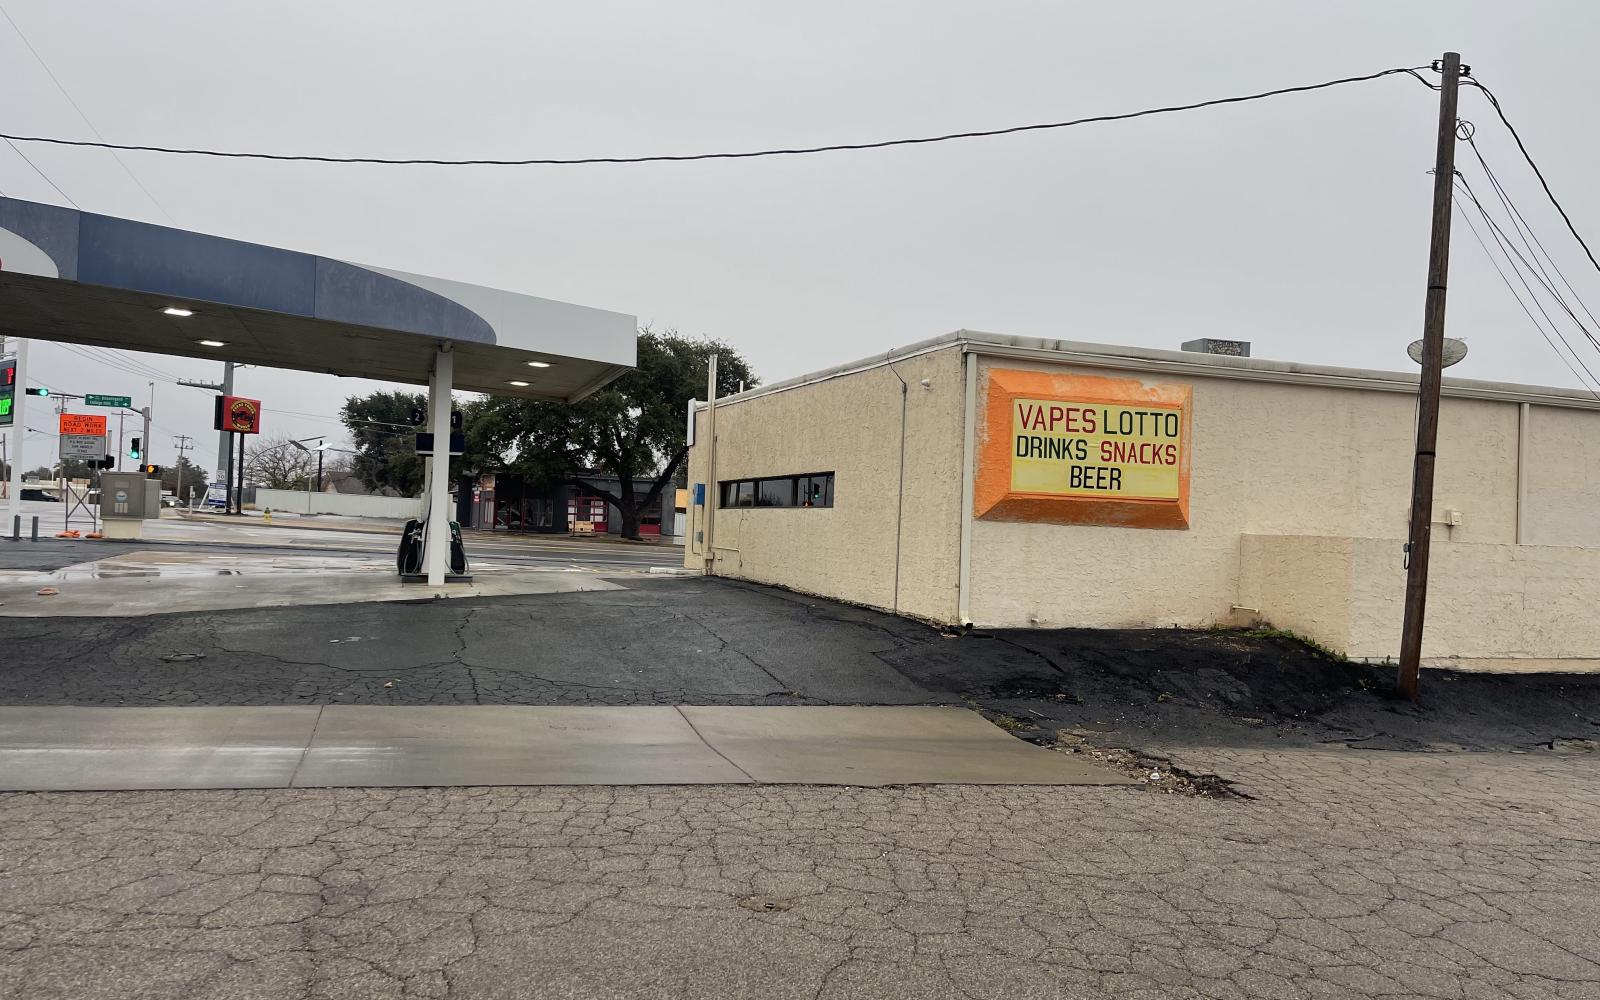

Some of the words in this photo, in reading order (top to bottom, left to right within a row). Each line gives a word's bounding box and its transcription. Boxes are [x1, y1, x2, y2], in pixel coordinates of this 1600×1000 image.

[1018, 403, 1096, 434] VAPES
[1103, 409, 1179, 438] LOTTO
[1016, 435, 1088, 461] DRINKS
[1100, 440, 1177, 466] SNACKS
[1070, 465, 1122, 490] BEER
